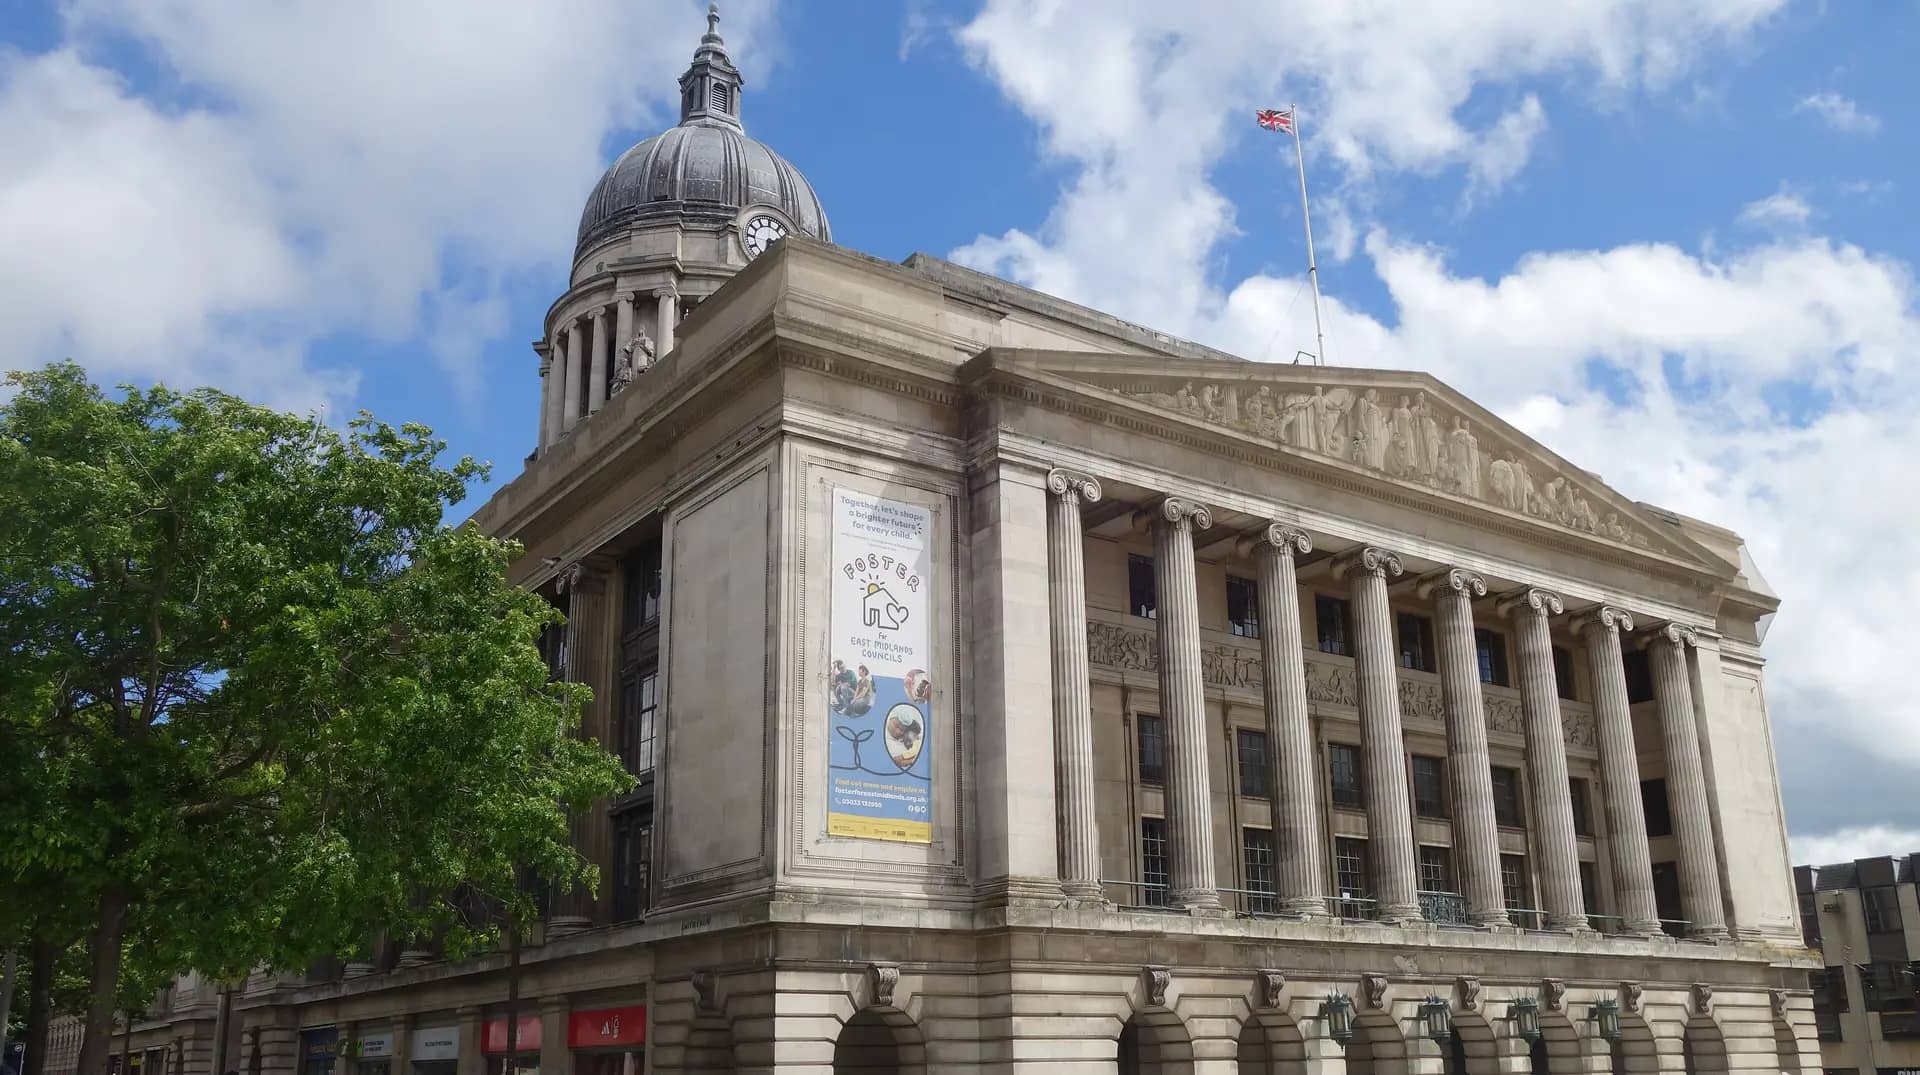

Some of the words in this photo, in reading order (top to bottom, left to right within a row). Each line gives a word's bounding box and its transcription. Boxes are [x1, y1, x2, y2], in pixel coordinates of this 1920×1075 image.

[841, 496, 880, 512] Together,
[881, 505, 898, 516] let's
[900, 510, 924, 521] shape
[856, 510, 890, 524] brighter
[891, 516, 916, 530] future
[853, 521, 865, 529] for
[866, 525, 890, 535] every
[891, 529, 912, 540] child.
[843, 553, 920, 593] FOSTER
[851, 636, 871, 646] EAST
[874, 639, 913, 655] MIDLANDS
[862, 649, 903, 663] COUNCILS
